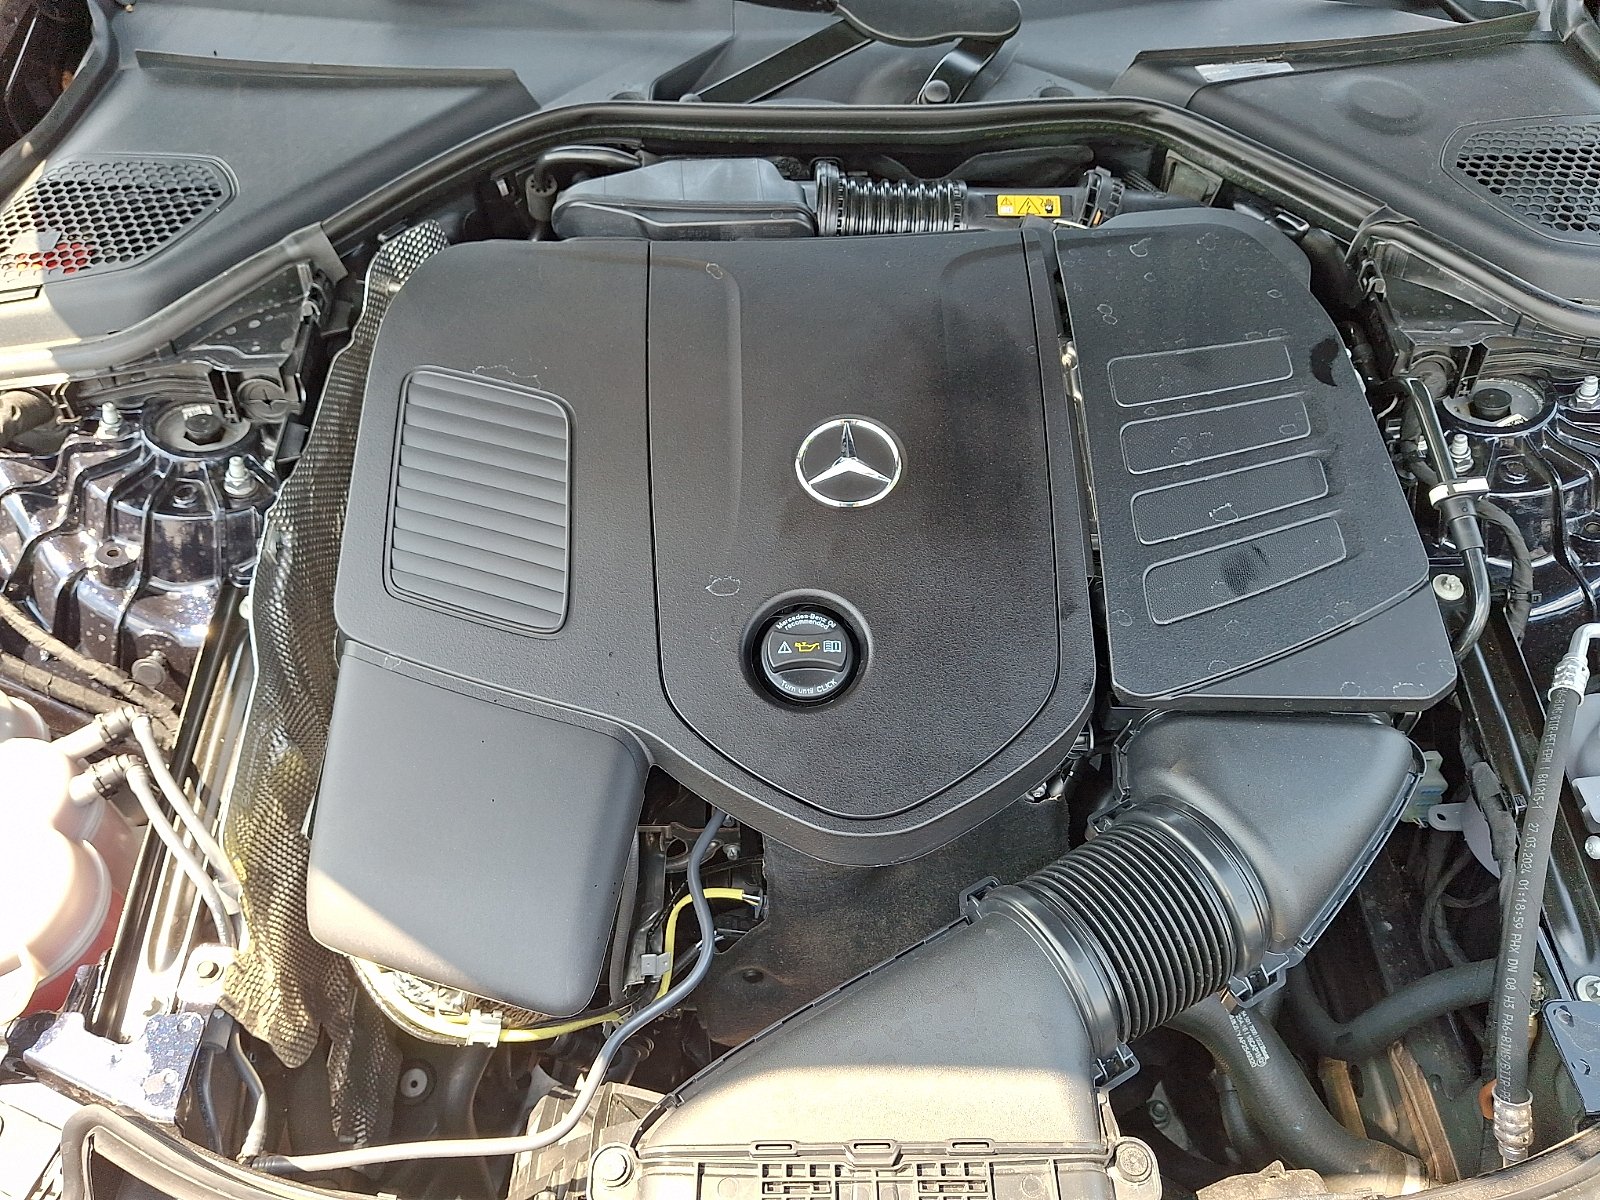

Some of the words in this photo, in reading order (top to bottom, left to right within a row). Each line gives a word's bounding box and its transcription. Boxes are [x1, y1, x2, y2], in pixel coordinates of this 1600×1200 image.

[776, 613, 827, 629] Mercedes-Benz
[827, 620, 837, 629] Oil
[784, 619, 830, 631] recommended
[781, 680, 796, 692] Turn
[816, 678, 837, 692] CLICK
[1520, 822, 1539, 875] 27.03.2024
[1512, 879, 1530, 930] 01:18:59
[1508, 933, 1522, 954] PHX
[1507, 958, 1519, 973] DN
[1504, 977, 1517, 991] 08
[1503, 995, 1515, 1010] H3
